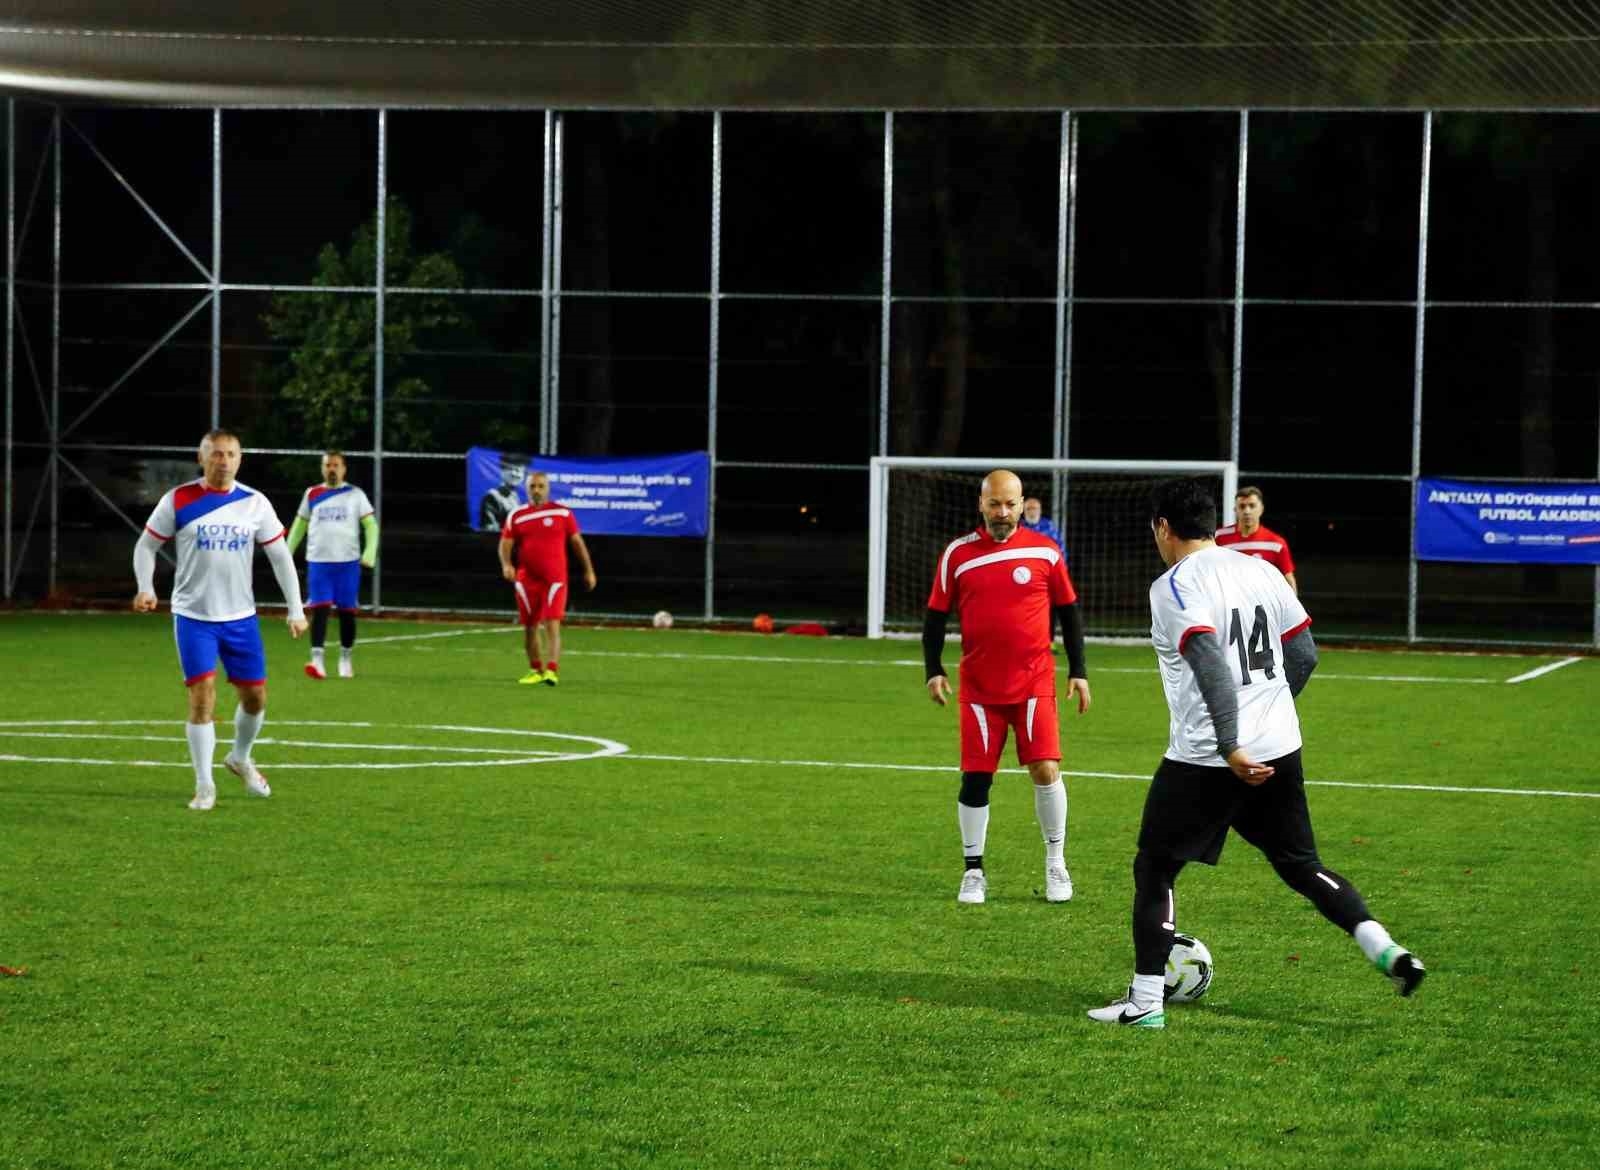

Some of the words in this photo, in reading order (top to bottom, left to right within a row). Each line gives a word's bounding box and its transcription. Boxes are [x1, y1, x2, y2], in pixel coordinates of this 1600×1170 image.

[1428, 490, 1492, 504] ANTALYA
[1479, 508, 1536, 521] FUTBOL
[1229, 604, 1276, 686] 14
